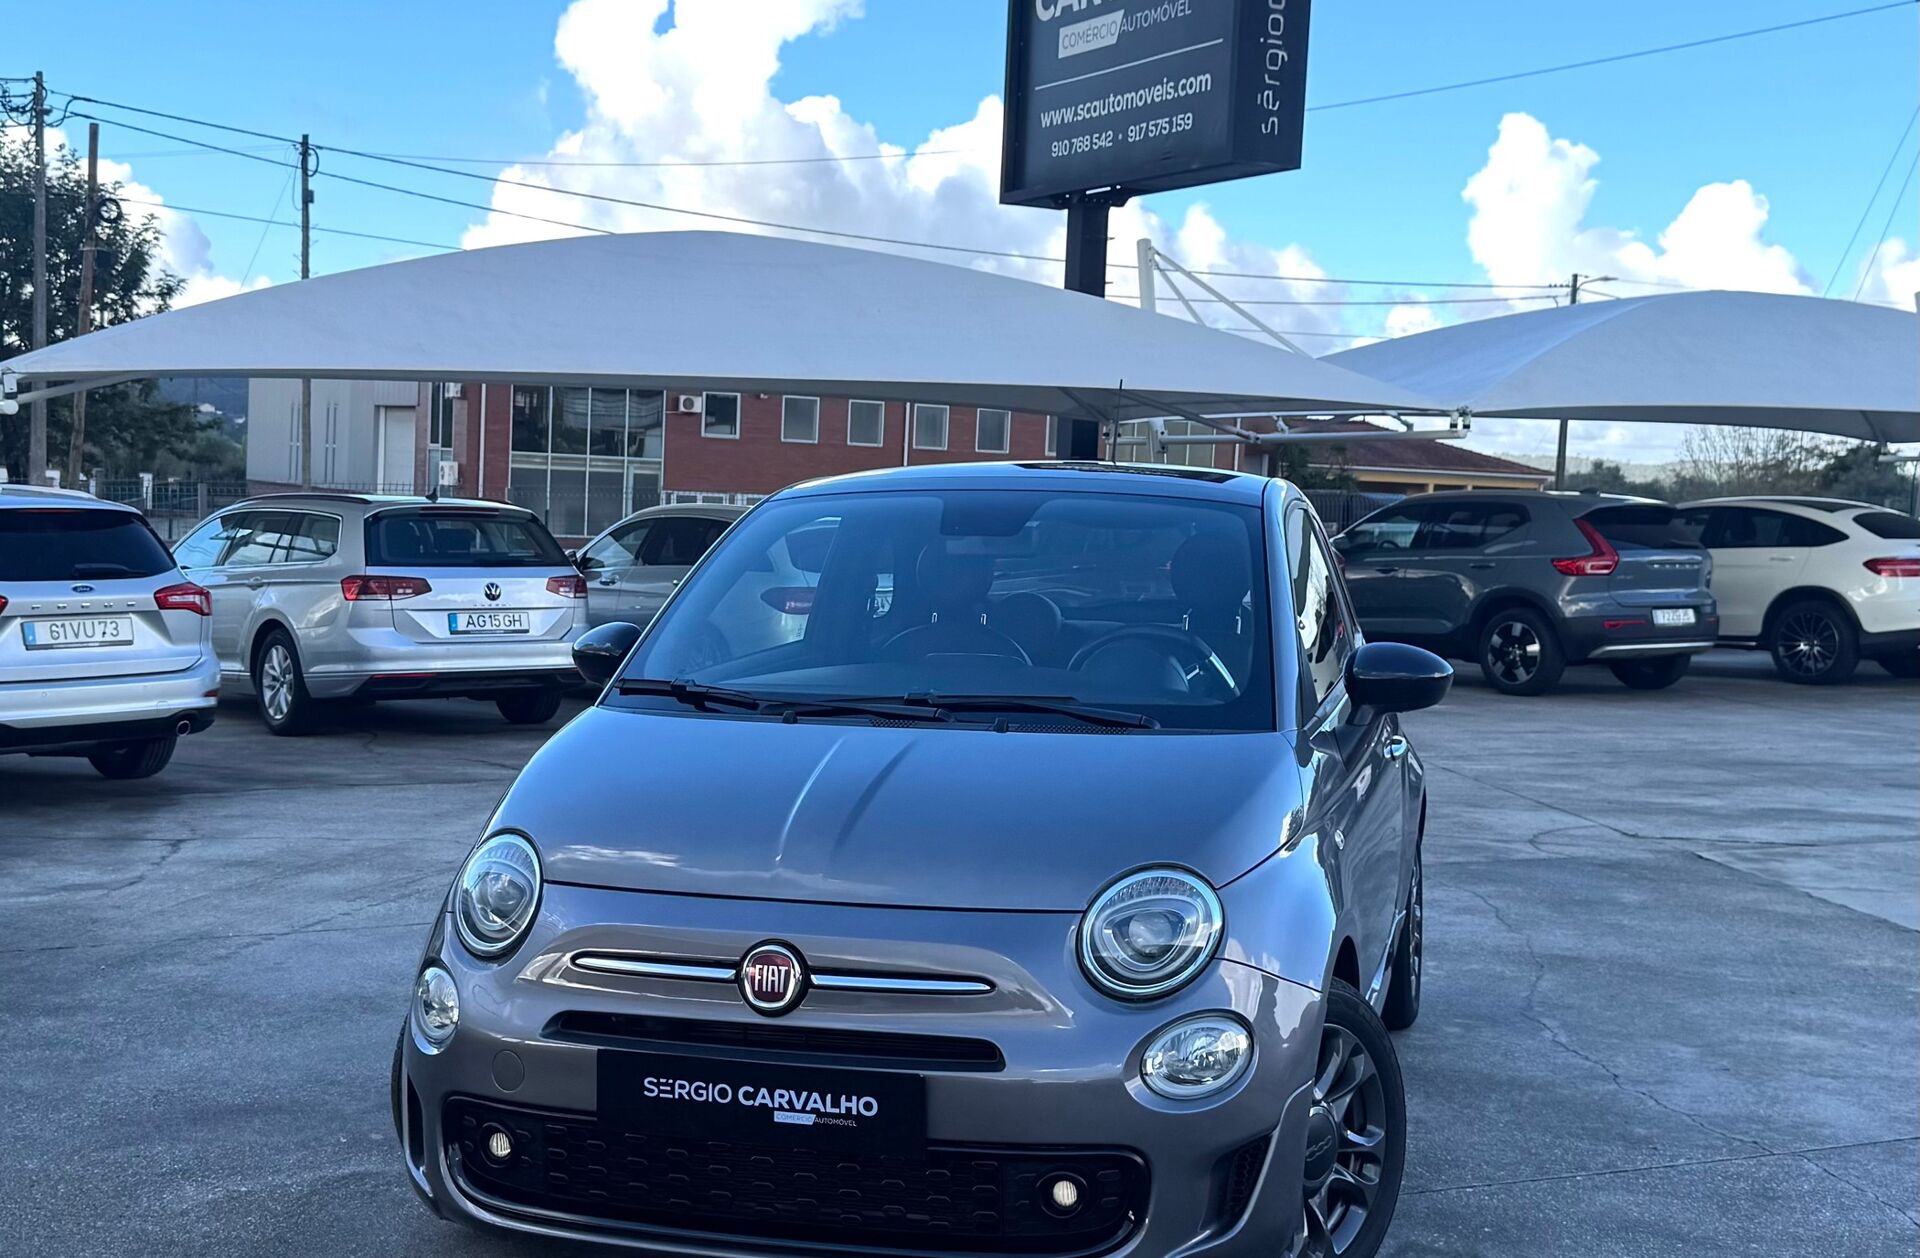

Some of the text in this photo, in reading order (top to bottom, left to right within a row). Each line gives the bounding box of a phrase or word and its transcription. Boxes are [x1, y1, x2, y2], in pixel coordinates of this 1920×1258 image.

[1061, 20, 1119, 50] COMÉRCIO
[1120, 1, 1193, 34] AUTOMÓVEL
[1040, 72, 1213, 128] www.scautomoveis.com
[1051, 112, 1194, 157] 910 768 542 917 575 159
[754, 964, 789, 993] FIAT
[738, 1085, 879, 1117] CARVALHO
